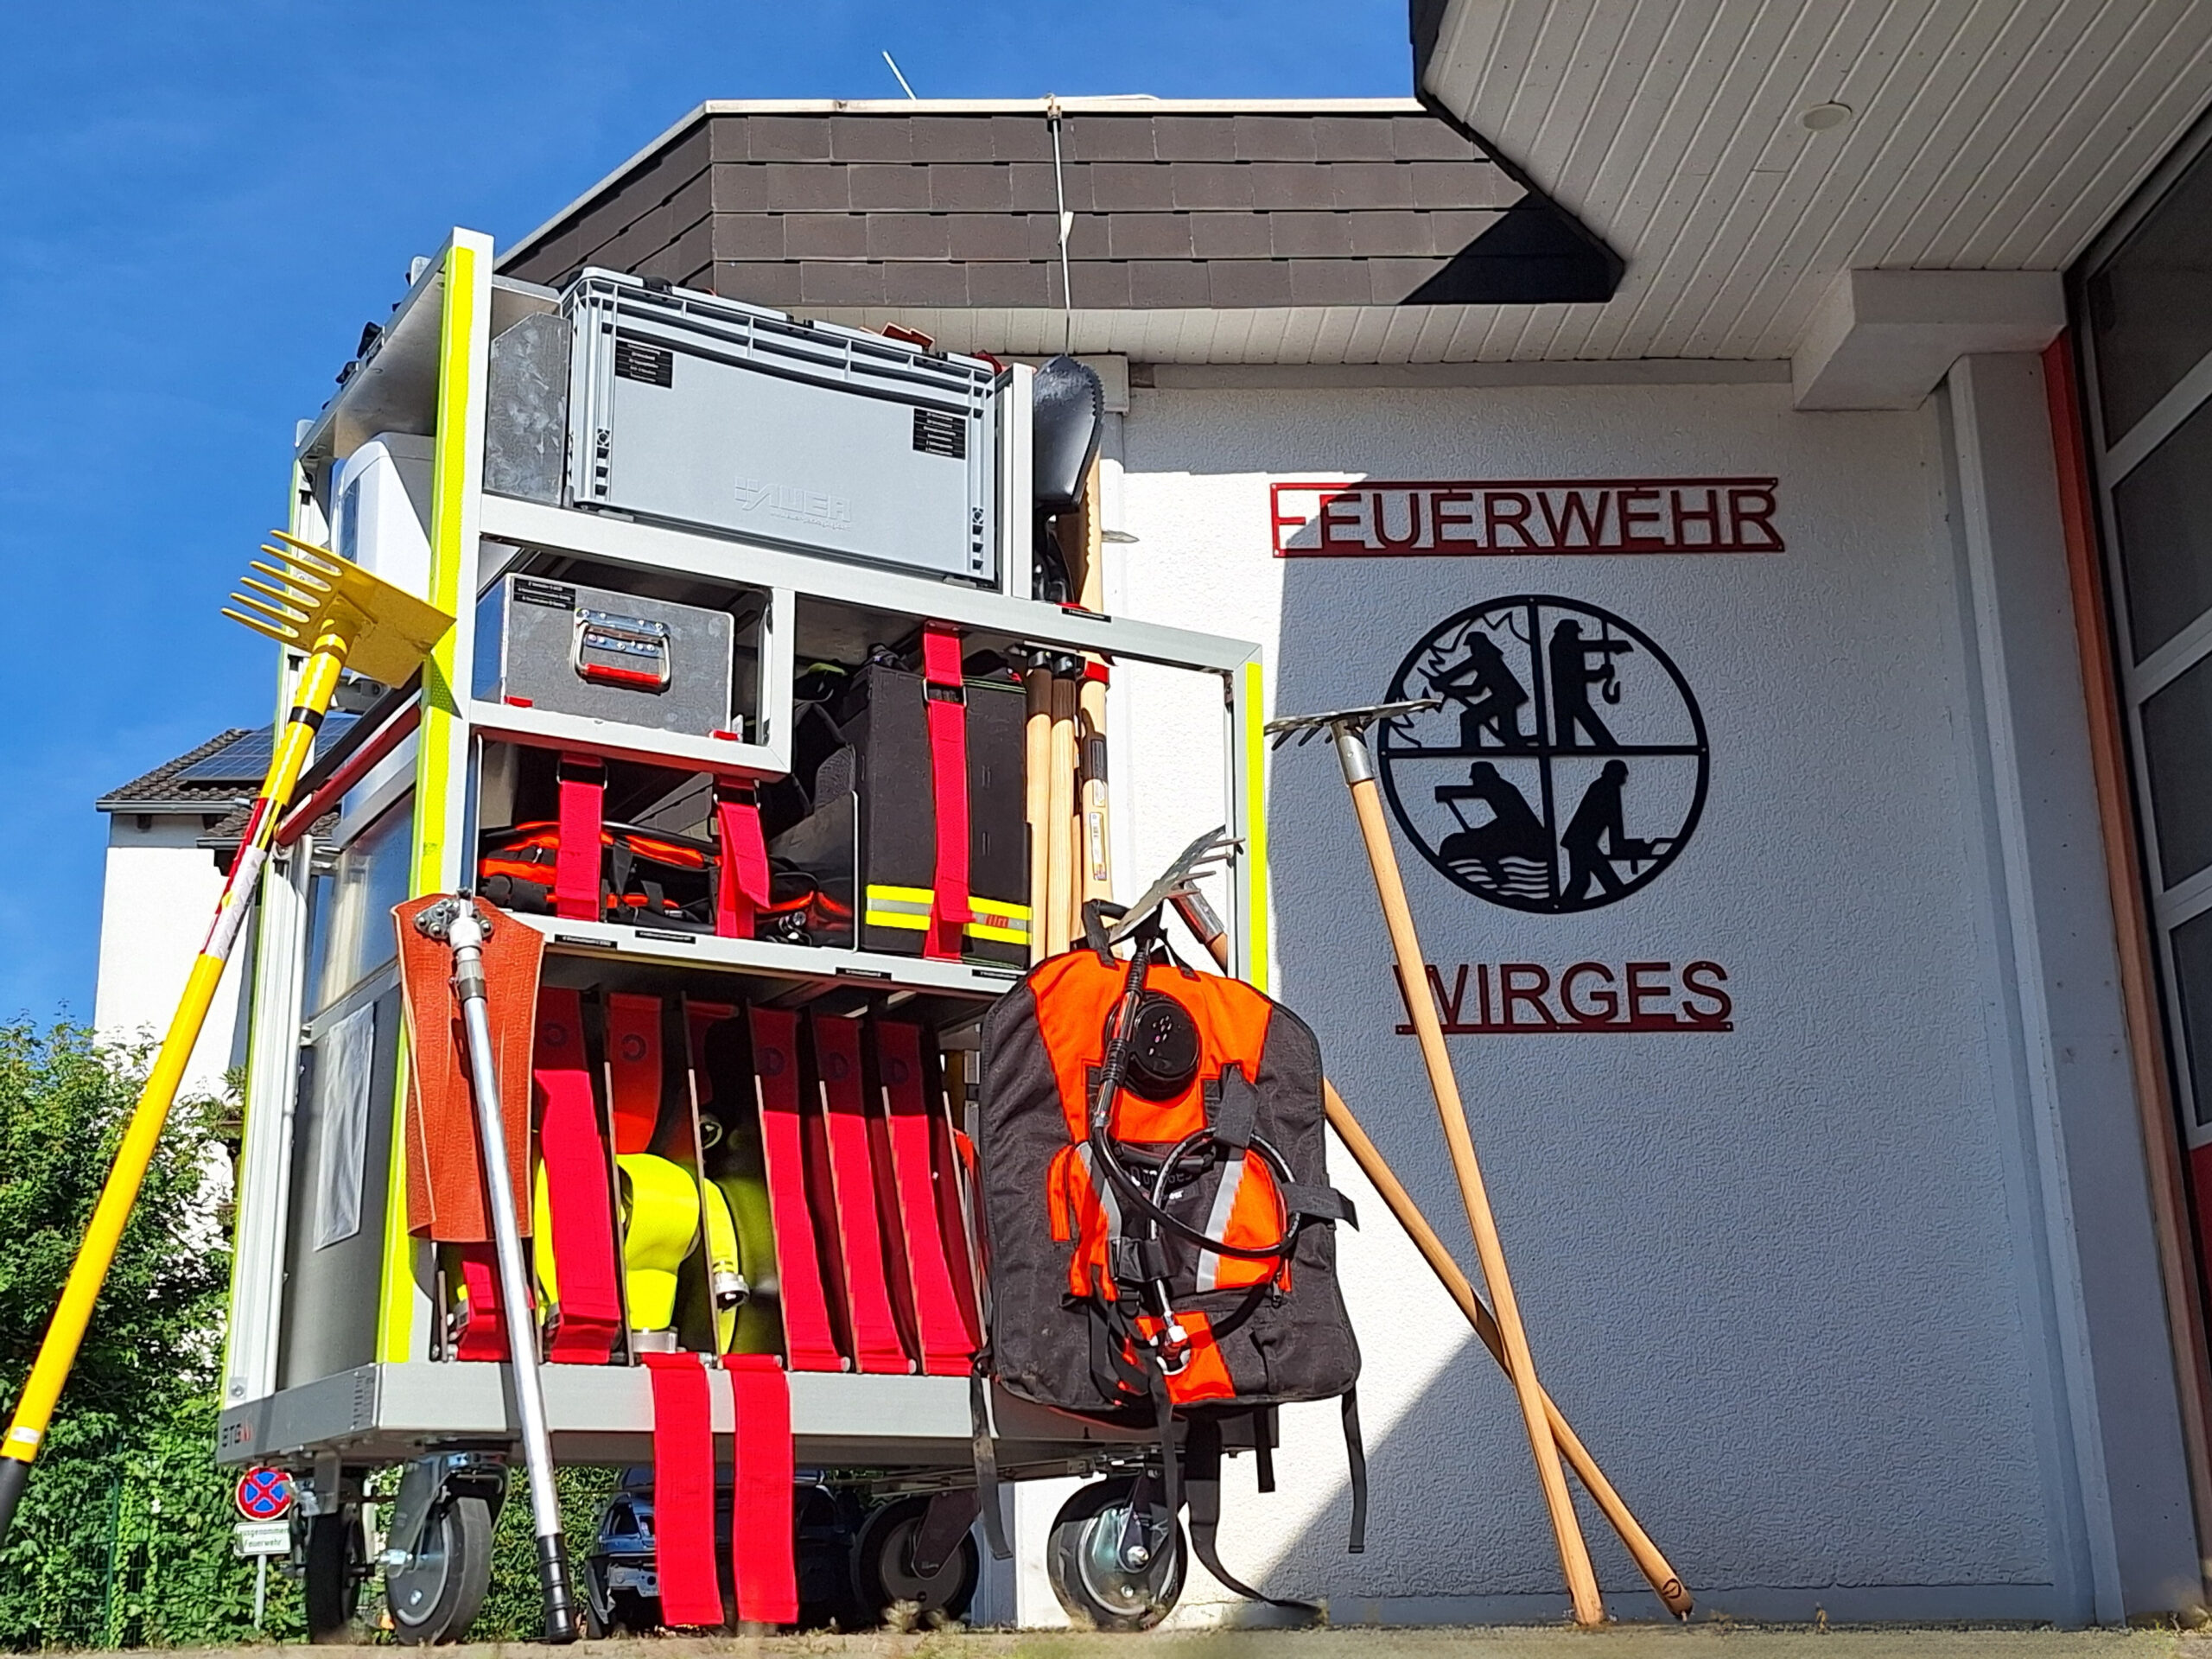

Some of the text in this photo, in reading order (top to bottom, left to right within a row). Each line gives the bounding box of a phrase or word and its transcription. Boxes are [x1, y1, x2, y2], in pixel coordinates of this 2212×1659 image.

[1271, 480, 1784, 556] FEUERWEHR
[1392, 958, 1732, 1030] WIRGES
[240, 1528, 289, 1538] usgenommen
